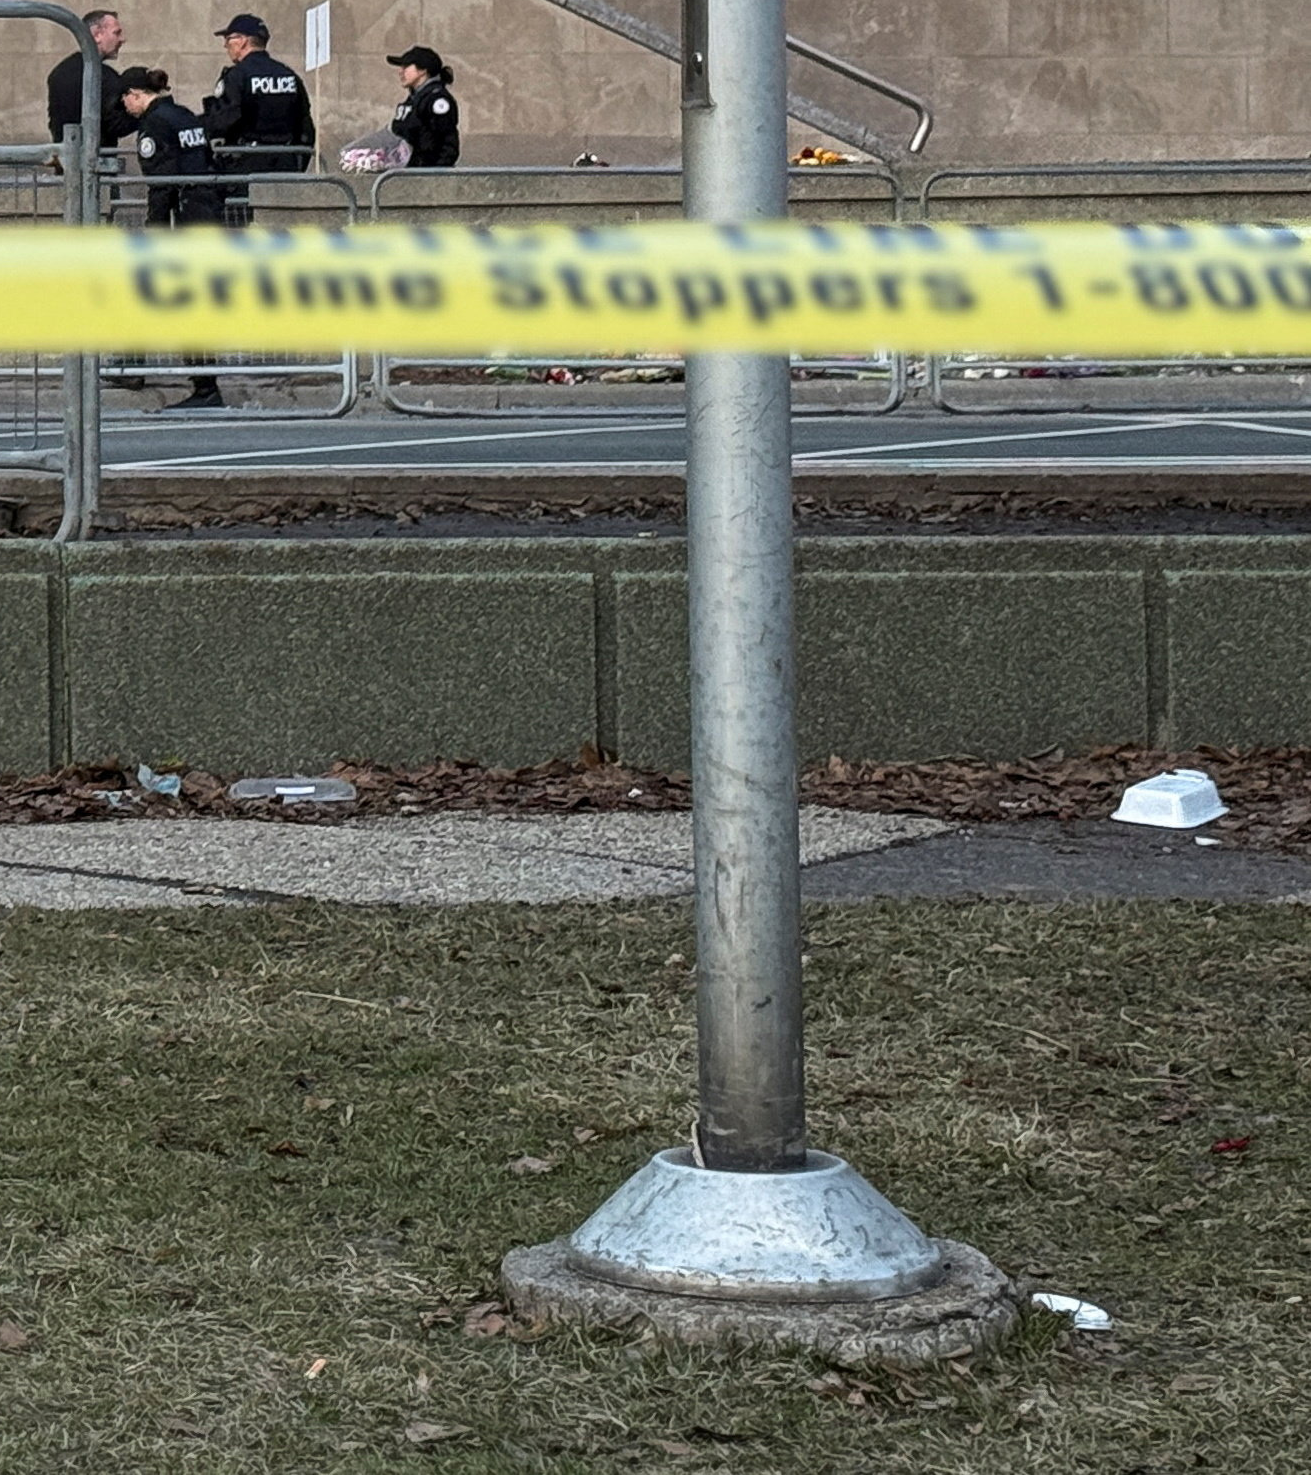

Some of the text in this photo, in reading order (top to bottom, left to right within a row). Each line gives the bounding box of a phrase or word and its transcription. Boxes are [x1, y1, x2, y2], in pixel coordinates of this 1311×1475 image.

[251, 75, 297, 95] POLICE
[130, 259, 446, 311] Crime
[488, 260, 978, 323] Stoppers
